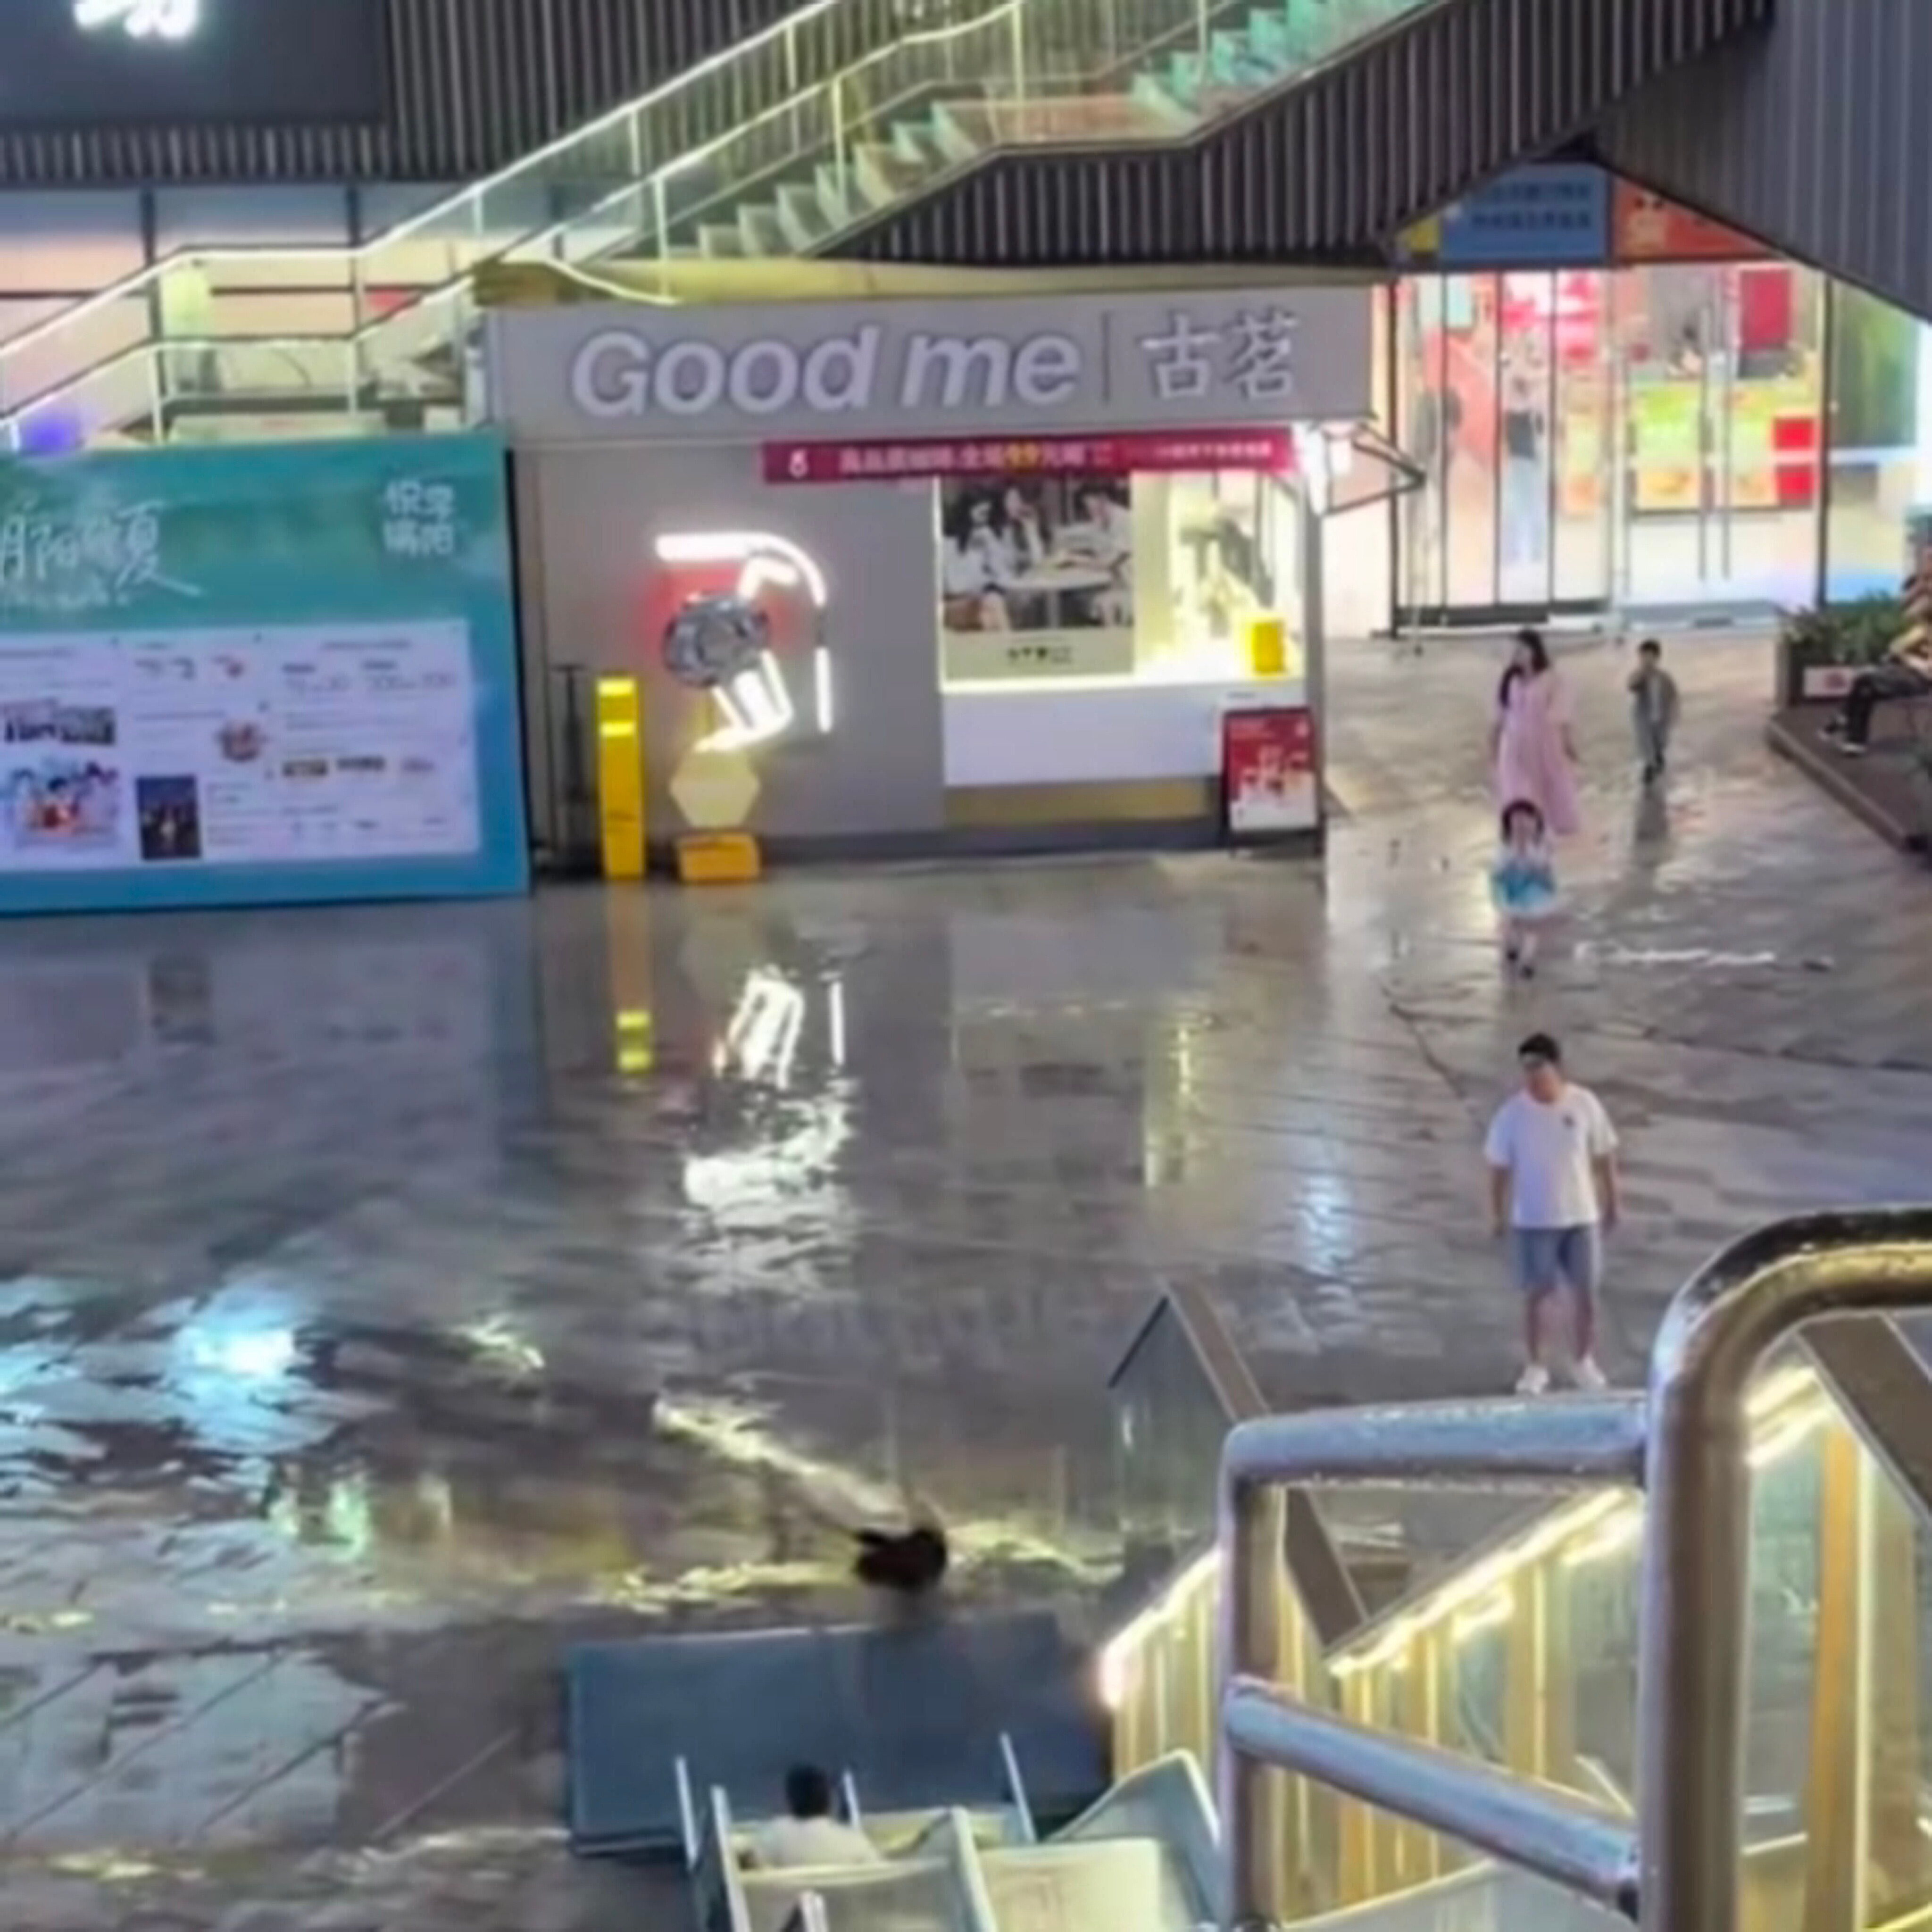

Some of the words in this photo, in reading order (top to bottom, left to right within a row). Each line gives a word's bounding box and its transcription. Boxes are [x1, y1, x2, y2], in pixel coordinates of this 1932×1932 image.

[571, 325, 881, 417] Good
[899, 335, 1082, 407] me
[1141, 307, 1300, 399] 古茗
